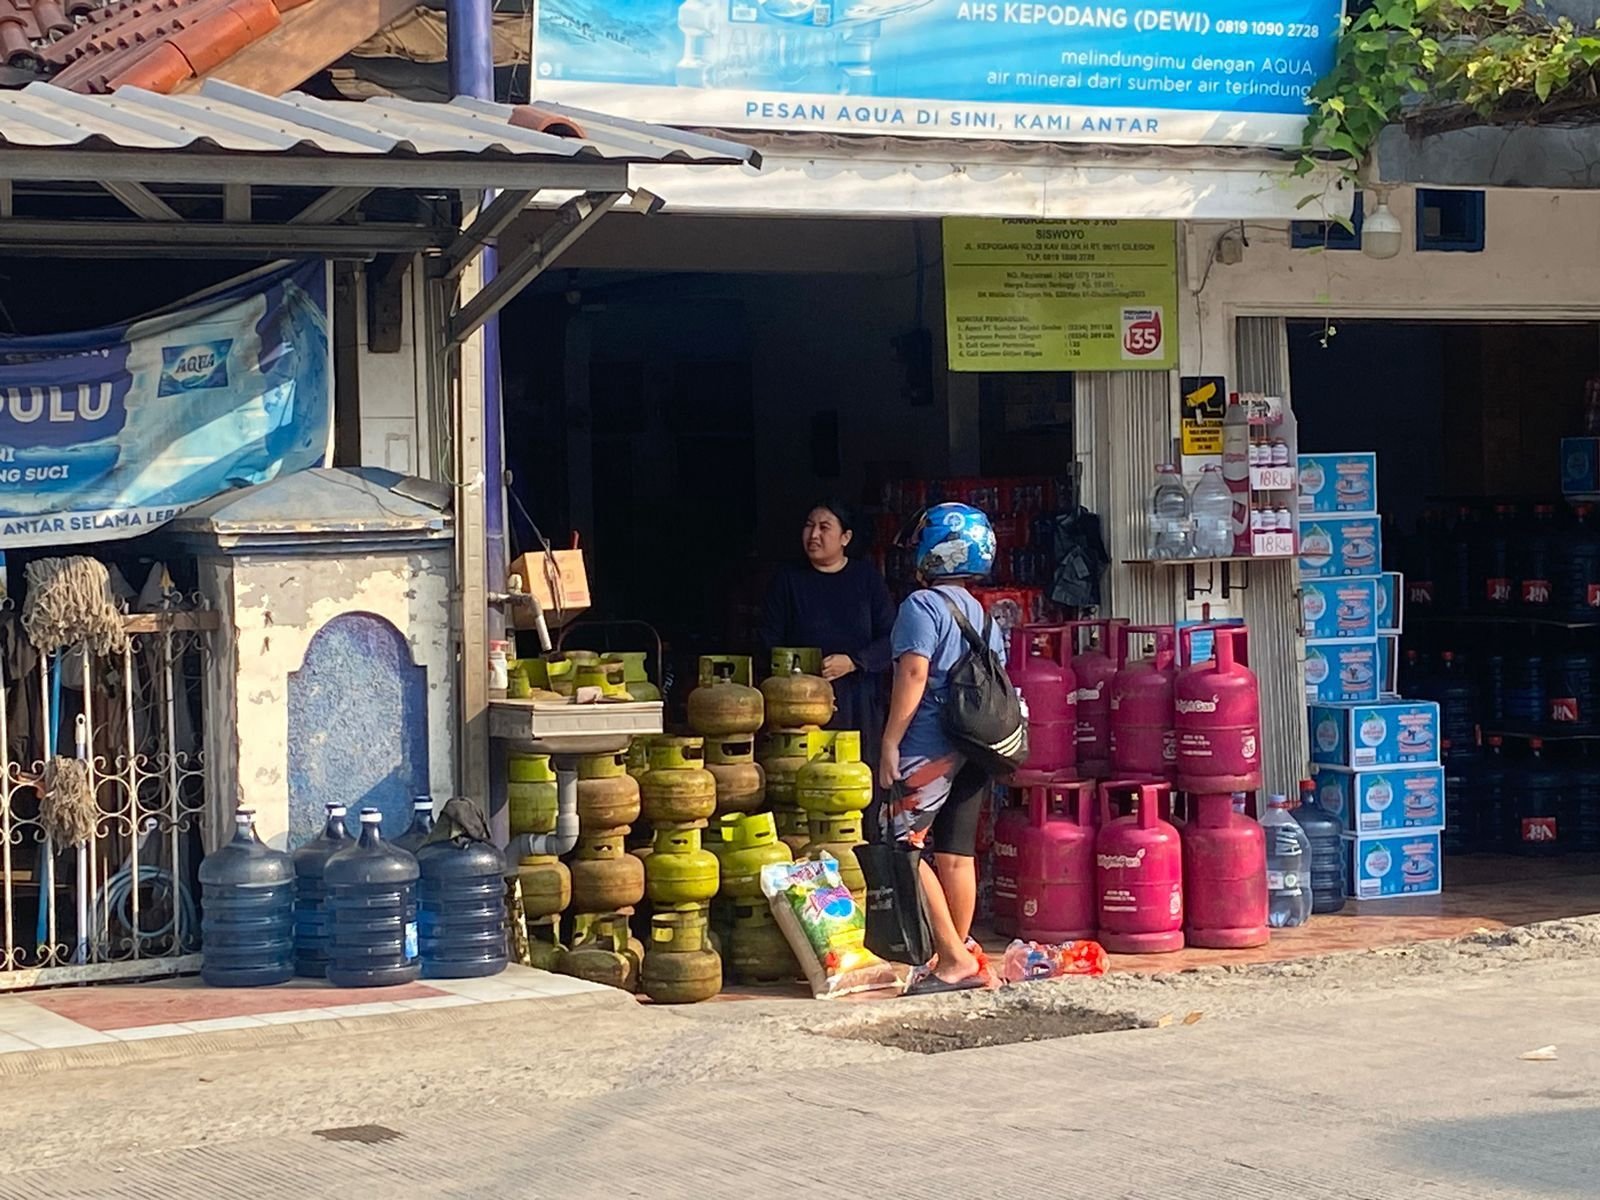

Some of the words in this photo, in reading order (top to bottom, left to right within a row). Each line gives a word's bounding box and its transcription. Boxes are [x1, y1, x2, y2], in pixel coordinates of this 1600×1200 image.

[957, 2, 997, 22] AHS
[1004, 3, 1127, 29] KEPODANG
[1134, 10, 1210, 35] (DEWI)
[1215, 19, 1248, 34] 0819
[1251, 22, 1284, 36] 1090
[1287, 24, 1319, 38] 2728
[1061, 50, 1186, 71] melindungimu
[1191, 55, 1254, 74] dengan
[1261, 57, 1317, 77] AQUA,
[987, 69, 1009, 84] air
[1016, 70, 1082, 88] mineral
[1088, 72, 1121, 89] dari
[1128, 75, 1192, 92] sumber
[1198, 78, 1219, 93] air
[1226, 79, 1315, 97] terlindung
[746, 101, 826, 121] PESAN
[837, 106, 904, 125] AQUA
[917, 109, 938, 126] DI
[950, 110, 1003, 131] SINI,
[1014, 113, 1071, 131] KAMI
[1081, 116, 1159, 134] ANTAR
[1036, 229, 1085, 240] SISWOYO
[1124, 327, 1157, 349] 135
[175, 351, 215, 374] AQUA
[0, 382, 112, 423] ULU
[25, 464, 69, 481] SUCI
[4, 518, 65, 535] ANTAR
[70, 512, 142, 531] SELAMA
